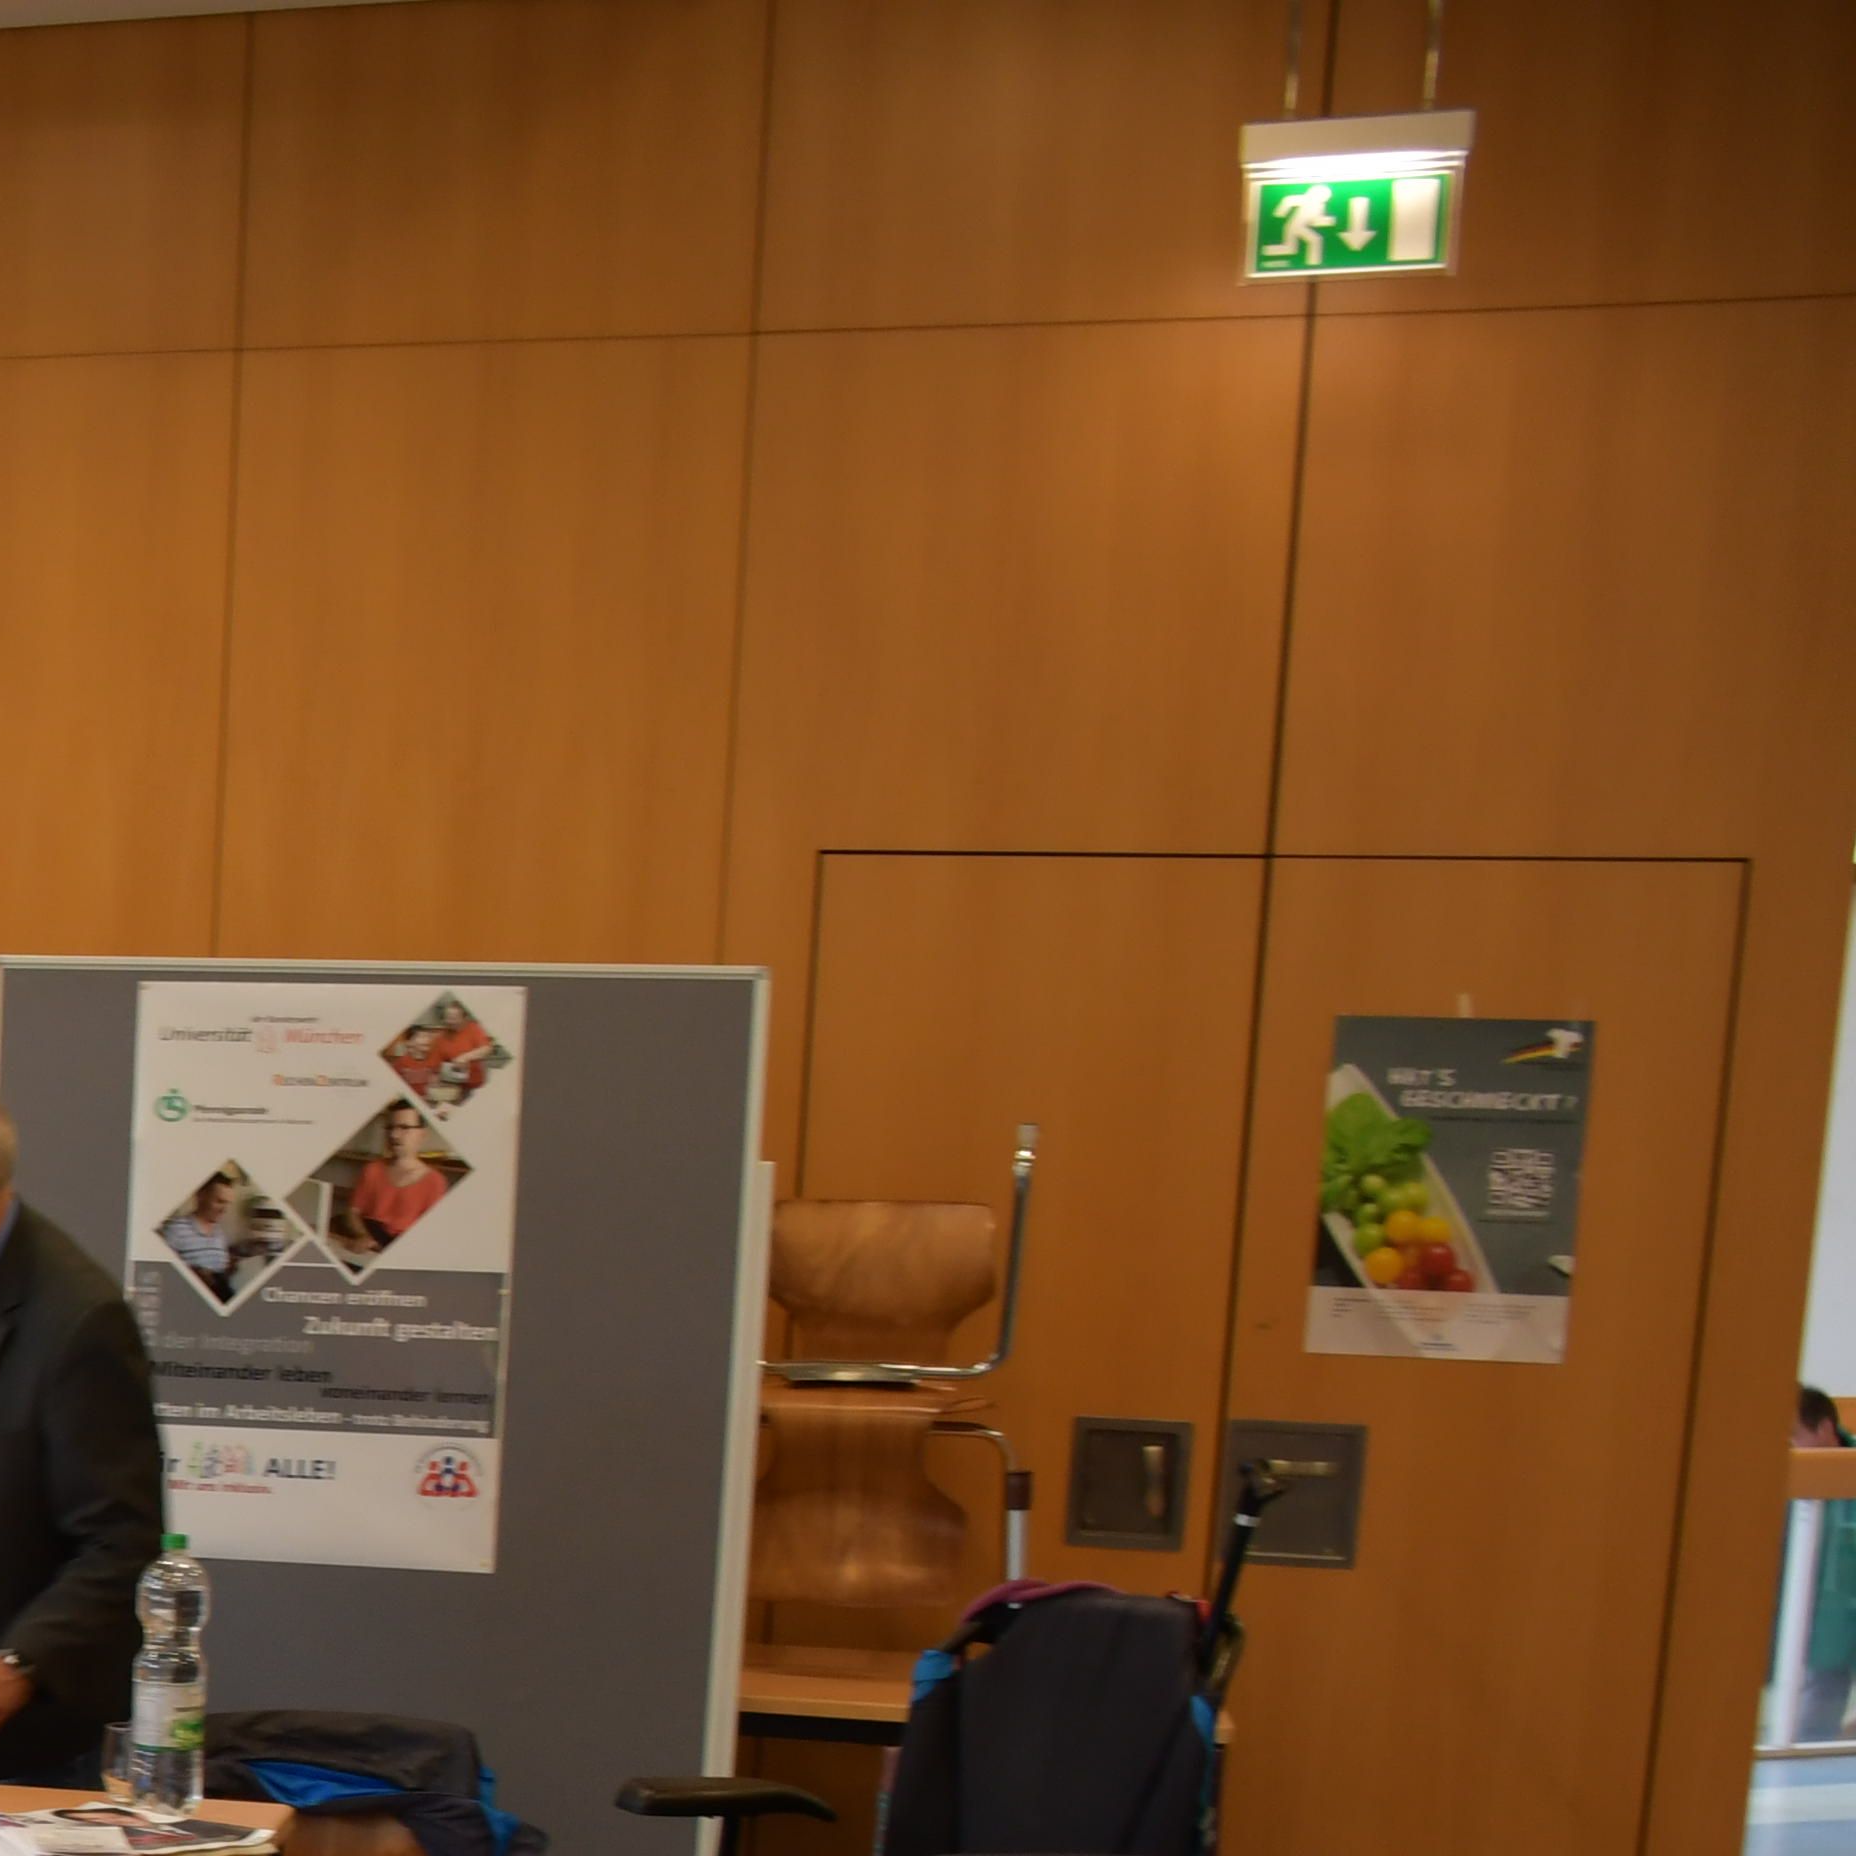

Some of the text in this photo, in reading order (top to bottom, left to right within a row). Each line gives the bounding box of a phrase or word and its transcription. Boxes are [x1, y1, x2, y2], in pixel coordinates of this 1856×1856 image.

[260, 1287, 428, 1308] Chancen eröffnen
[302, 1316, 499, 1342] Zukunft gestalten
[200, 1334, 314, 1355] Integration
[195, 1403, 221, 1418] im
[223, 1405, 343, 1424] Arbeitsleben
[263, 1456, 337, 1479] ALLE!
